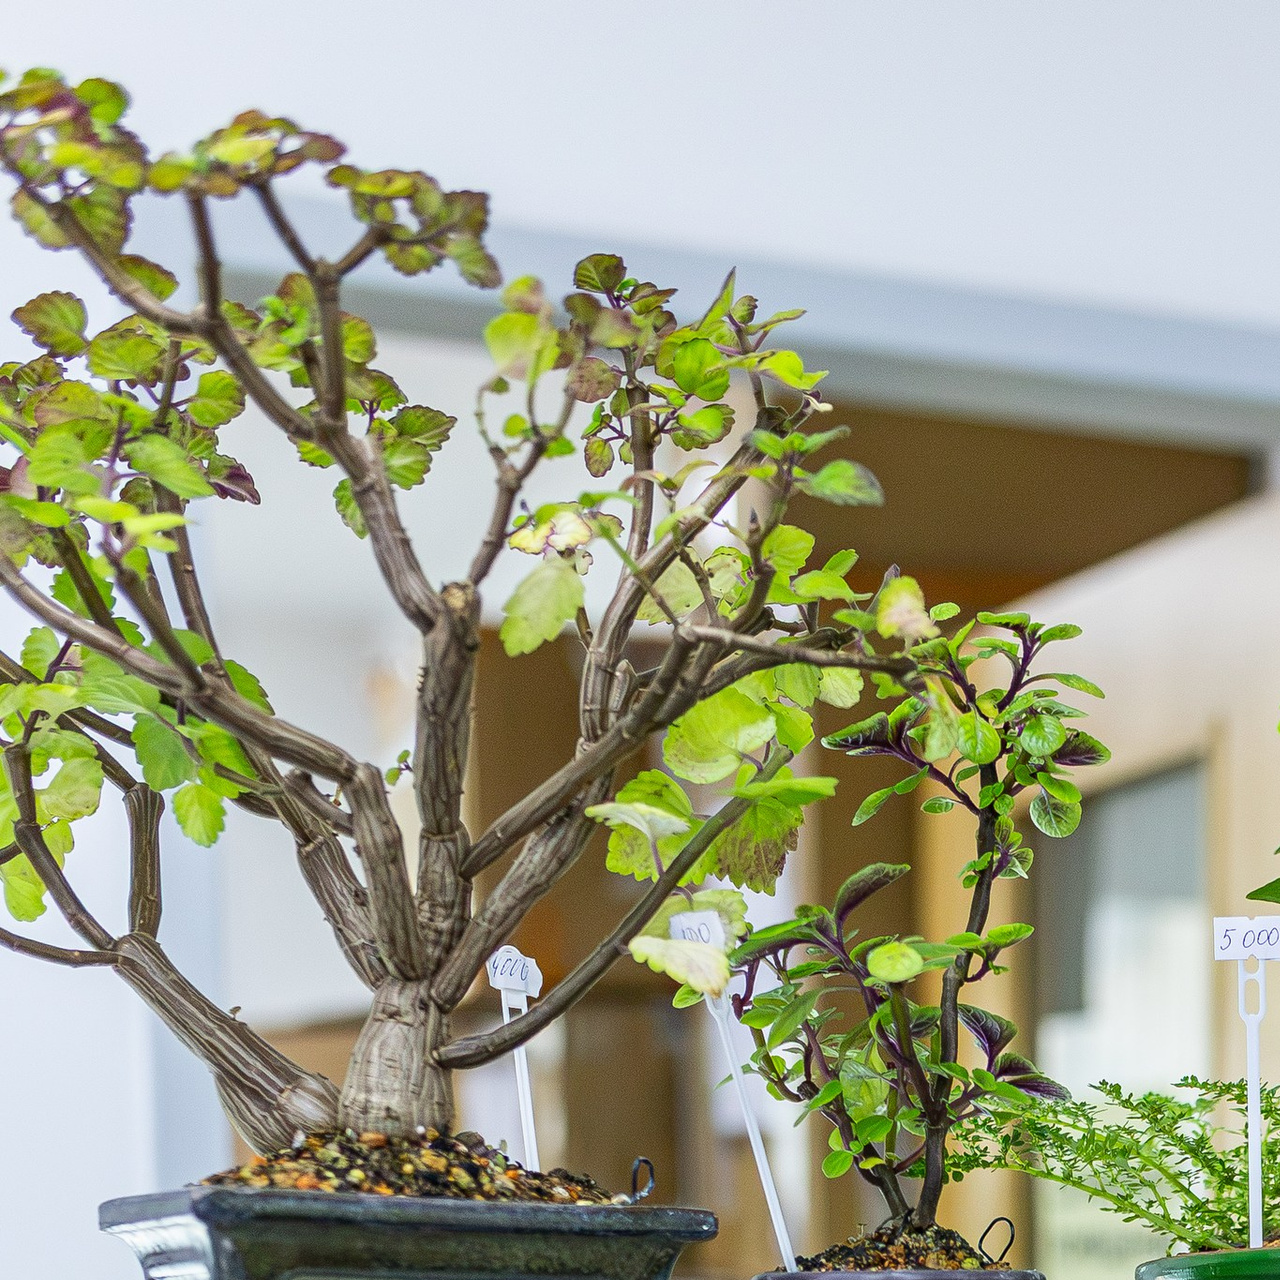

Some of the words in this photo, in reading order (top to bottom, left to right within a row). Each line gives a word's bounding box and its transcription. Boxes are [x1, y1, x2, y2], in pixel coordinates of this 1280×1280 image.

[1220, 928, 1237, 951] 5
[1242, 927, 1280, 949] 000
[492, 956, 530, 982] 4000
